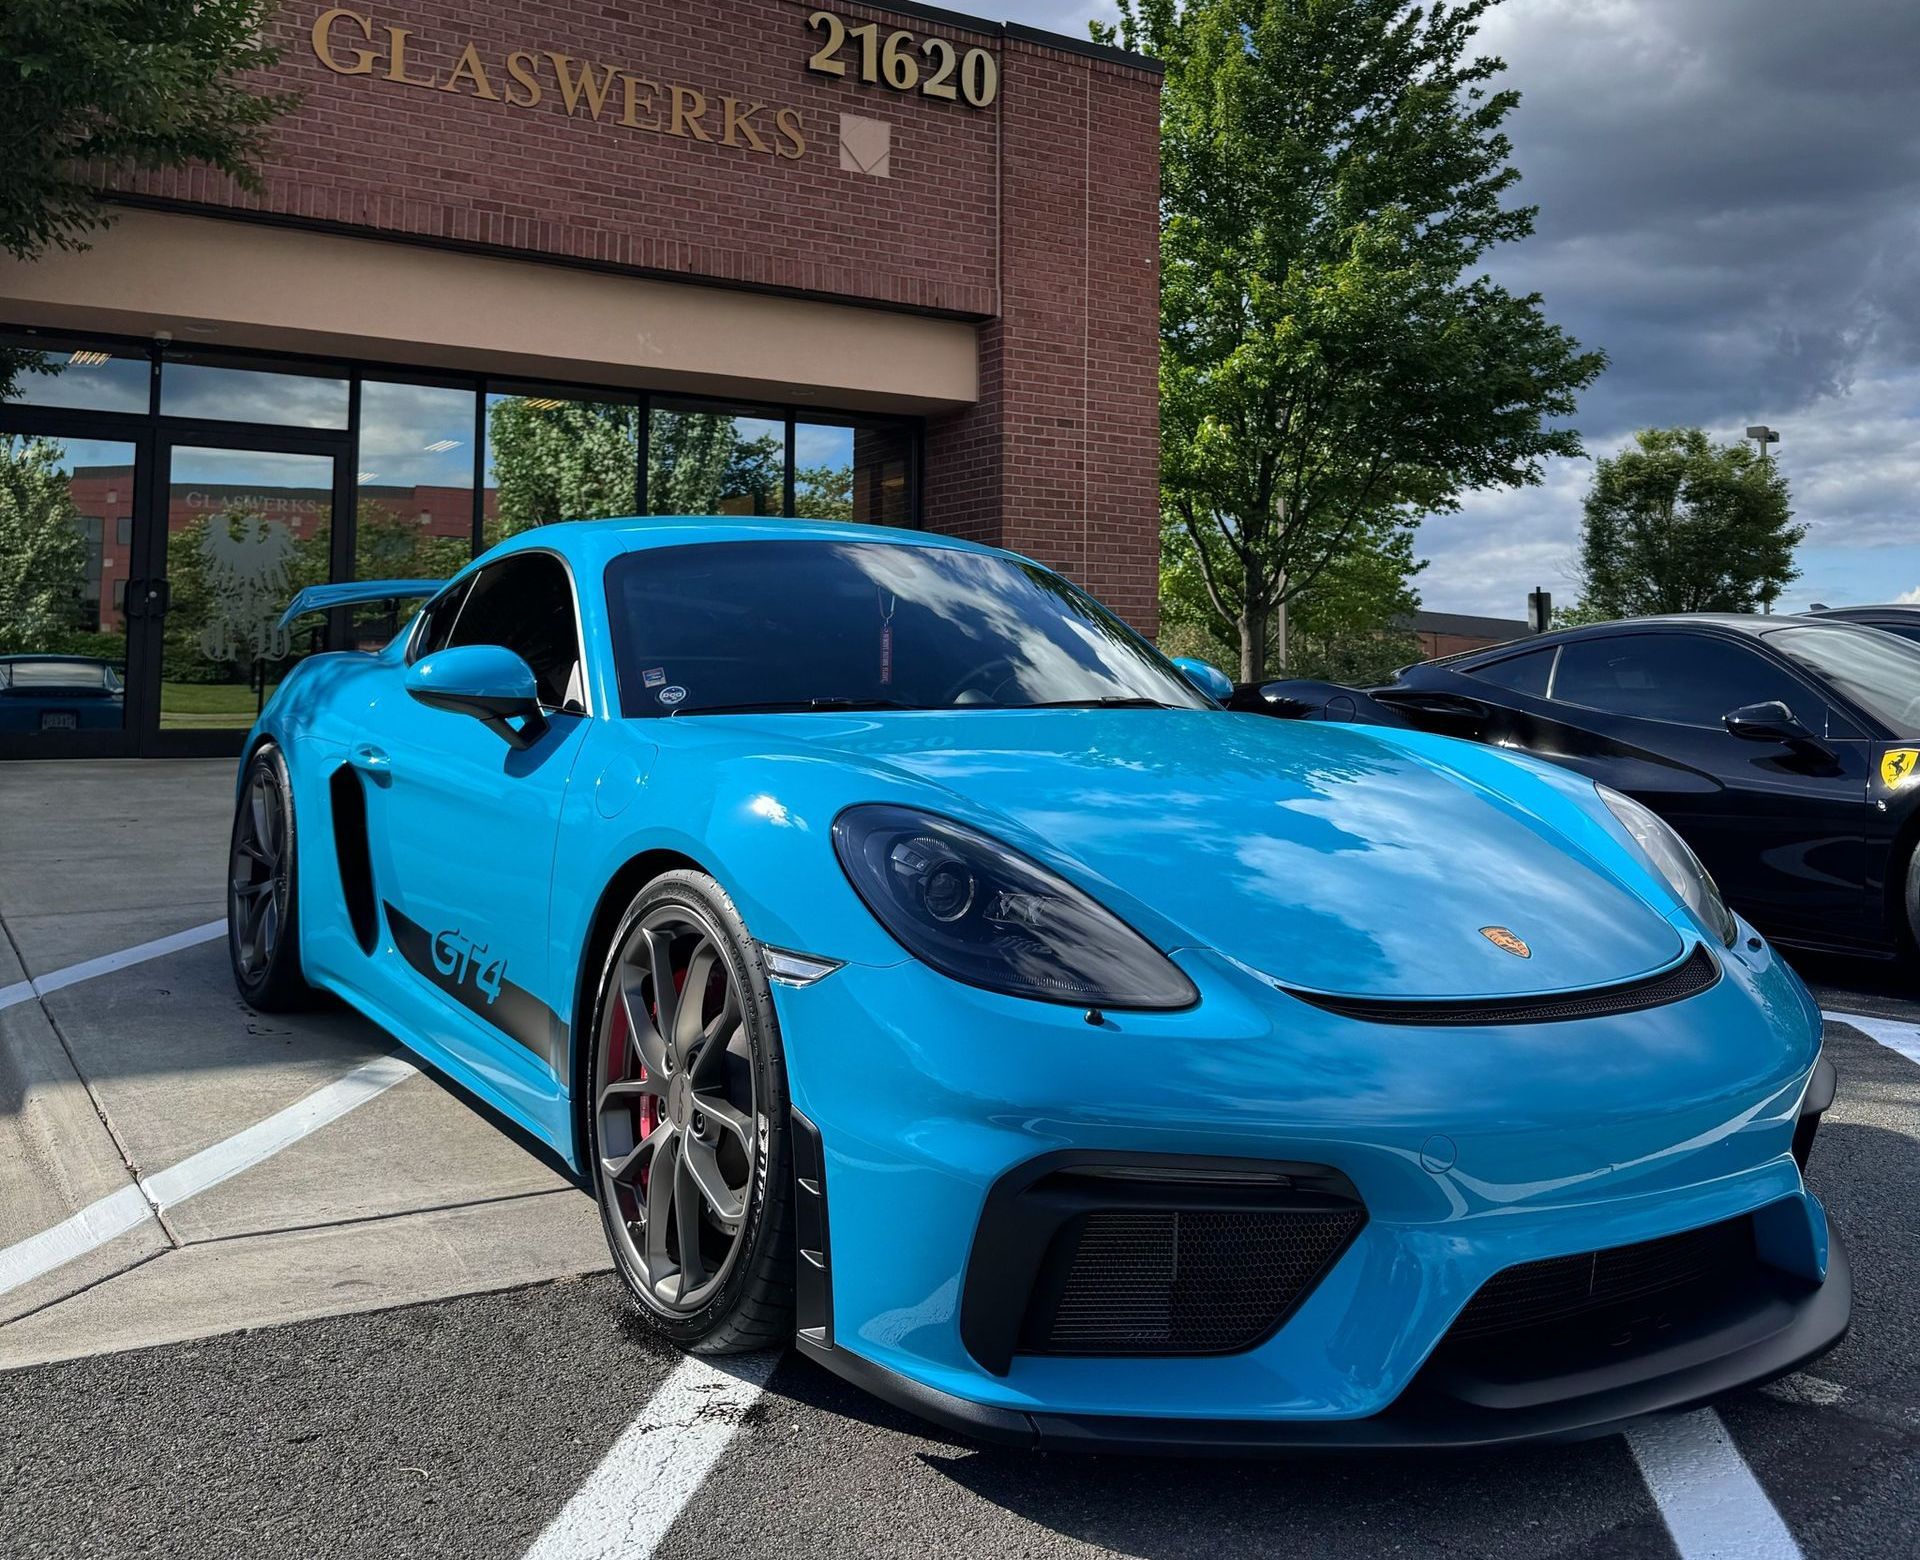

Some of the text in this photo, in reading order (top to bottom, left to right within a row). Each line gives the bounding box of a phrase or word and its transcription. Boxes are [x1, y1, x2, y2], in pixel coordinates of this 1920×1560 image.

[311, 8, 806, 161] GLASWERKS
[806, 11, 999, 108] 21620
[186, 491, 317, 514] GLASWERKS
[431, 928, 508, 1005] GT4
